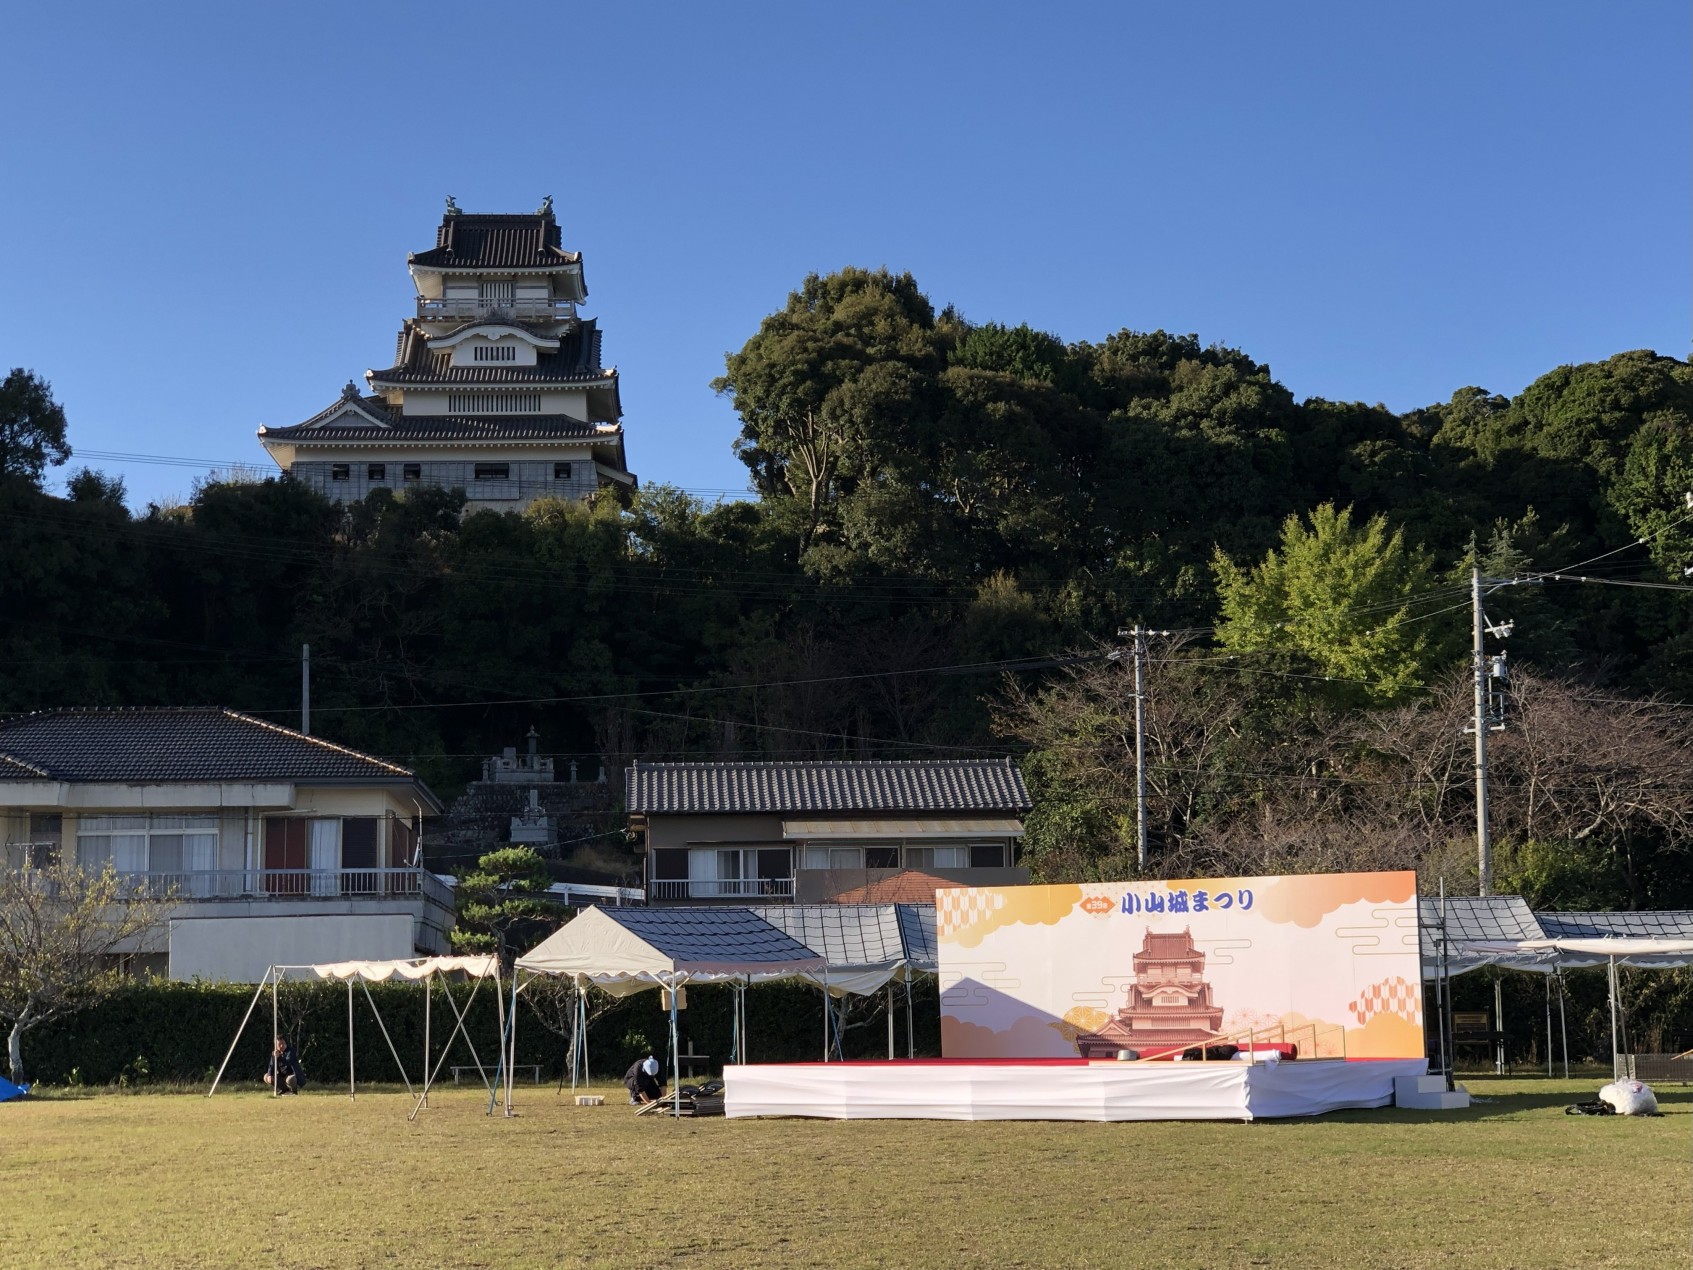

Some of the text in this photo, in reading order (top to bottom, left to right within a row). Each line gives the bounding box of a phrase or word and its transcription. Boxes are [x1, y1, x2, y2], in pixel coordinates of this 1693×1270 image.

[1121, 889, 1254, 914] 小山城まつり
